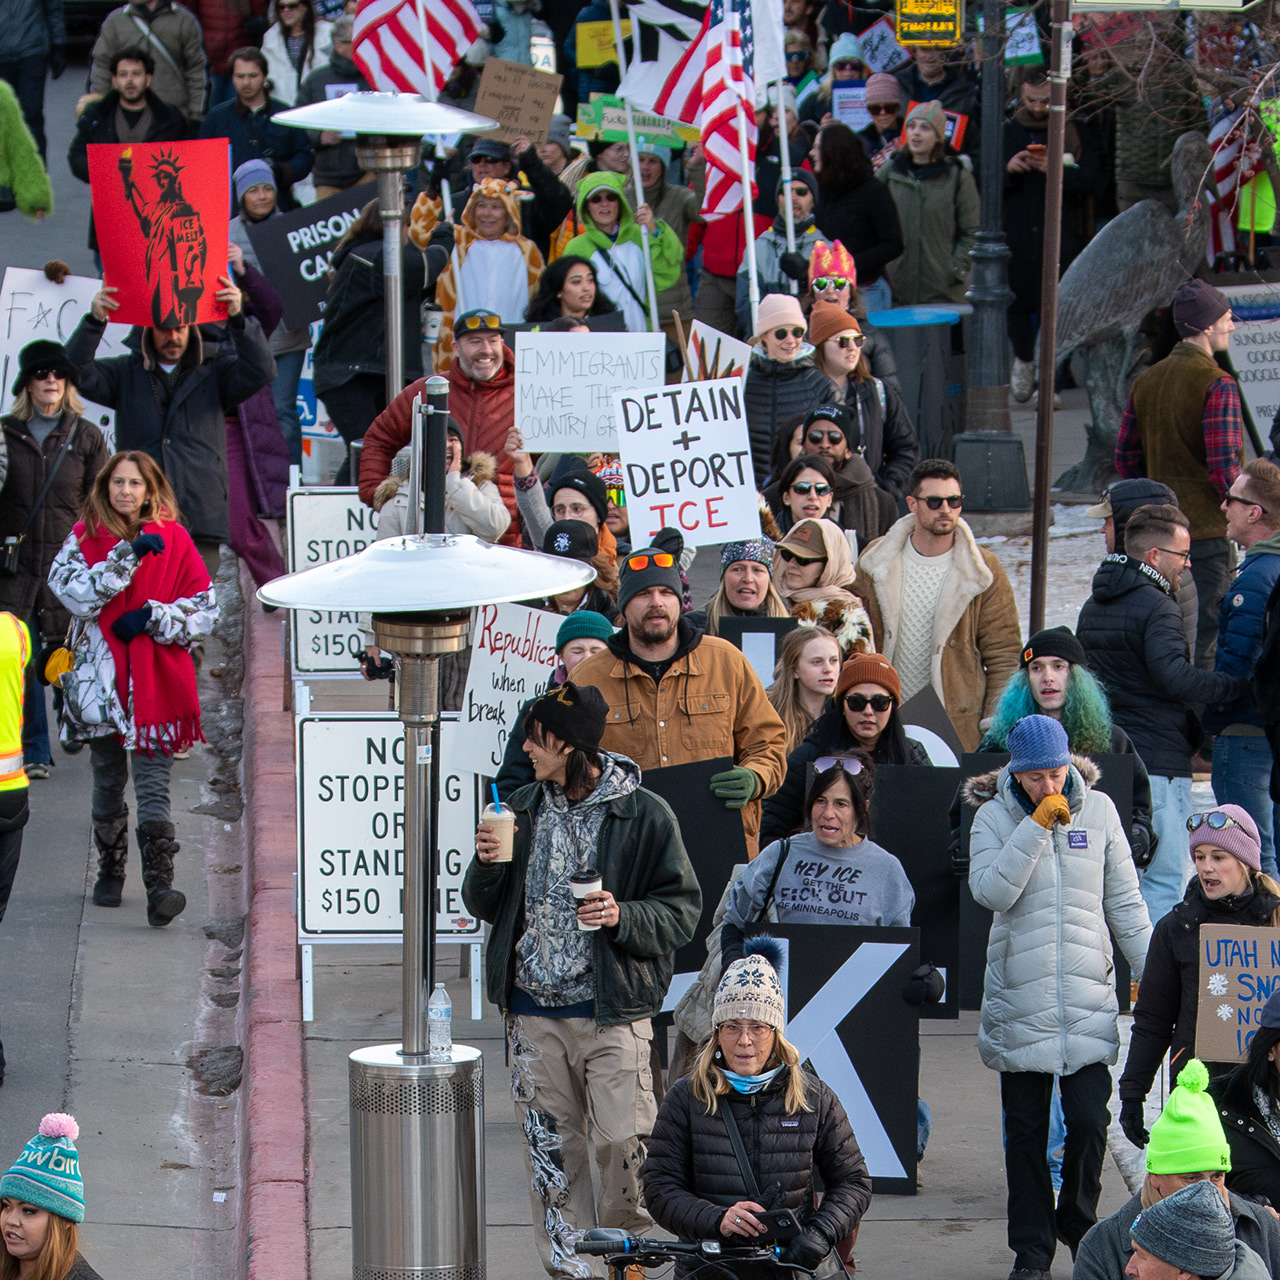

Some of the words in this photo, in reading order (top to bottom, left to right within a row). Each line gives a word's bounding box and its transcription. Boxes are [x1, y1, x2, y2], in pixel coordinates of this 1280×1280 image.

[176, 229, 200, 244] MELT
[180, 220, 194, 231] ICE
[518, 348, 661, 380] IMMIGRANTS
[520, 383, 572, 412] MAKE
[621, 385, 741, 433] DETAIN
[521, 412, 588, 440] COUNTRY
[673, 430, 701, 450] +
[627, 451, 749, 497] DEPORT
[649, 496, 728, 537] ICE
[492, 663, 525, 693] when
[468, 690, 506, 725] break
[794, 860, 829, 878] HEY
[832, 866, 862, 884] ICE
[803, 878, 822, 887] GET
[826, 882, 845, 892] THE
[321, 889, 380, 914] $150
[778, 901, 790, 909] OF
[792, 903, 860, 921] MINNEAPOLIS
[828, 890, 867, 905] OUT
[1206, 939, 1258, 968] UTAH
